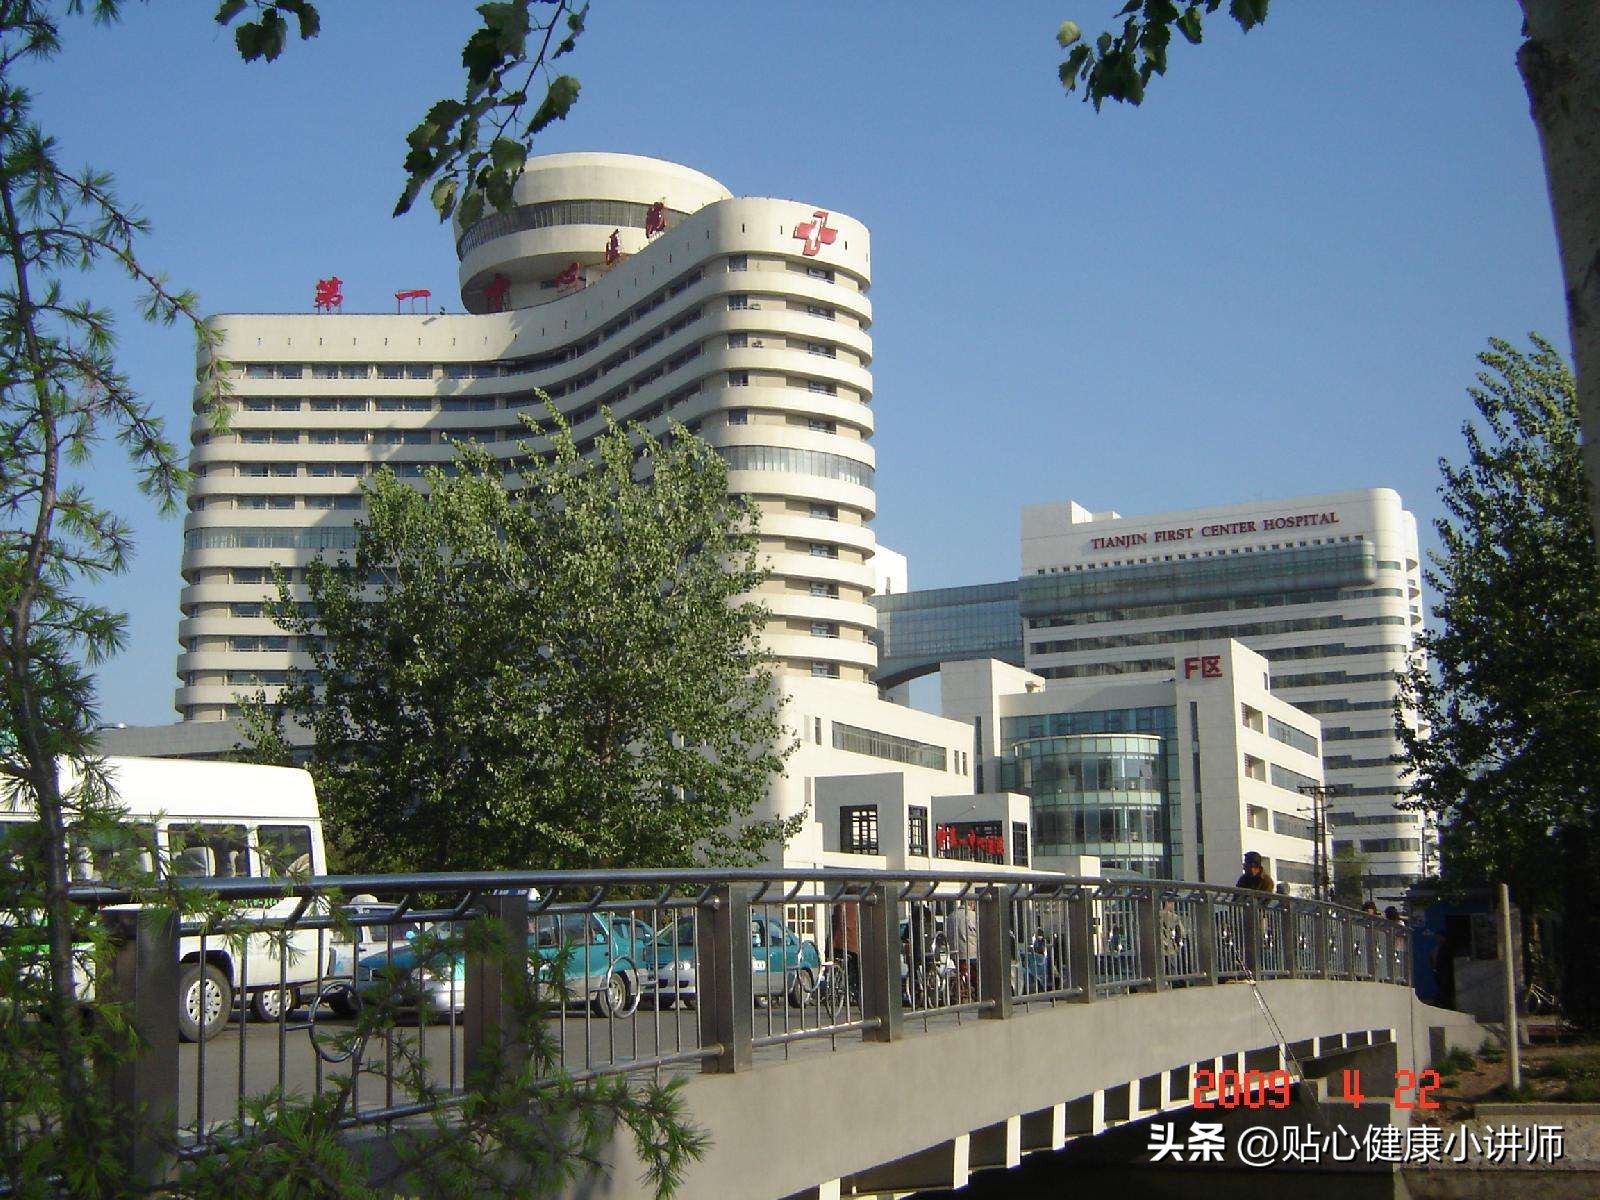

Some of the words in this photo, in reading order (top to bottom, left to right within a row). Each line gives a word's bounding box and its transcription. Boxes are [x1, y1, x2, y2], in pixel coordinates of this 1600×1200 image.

[1091, 532, 1147, 550] TIANJIN
[1154, 527, 1194, 544] FIRST
[1201, 520, 1257, 538] CENTER
[1263, 511, 1340, 532] HOSPITAL
[1184, 655, 1223, 679] F区
